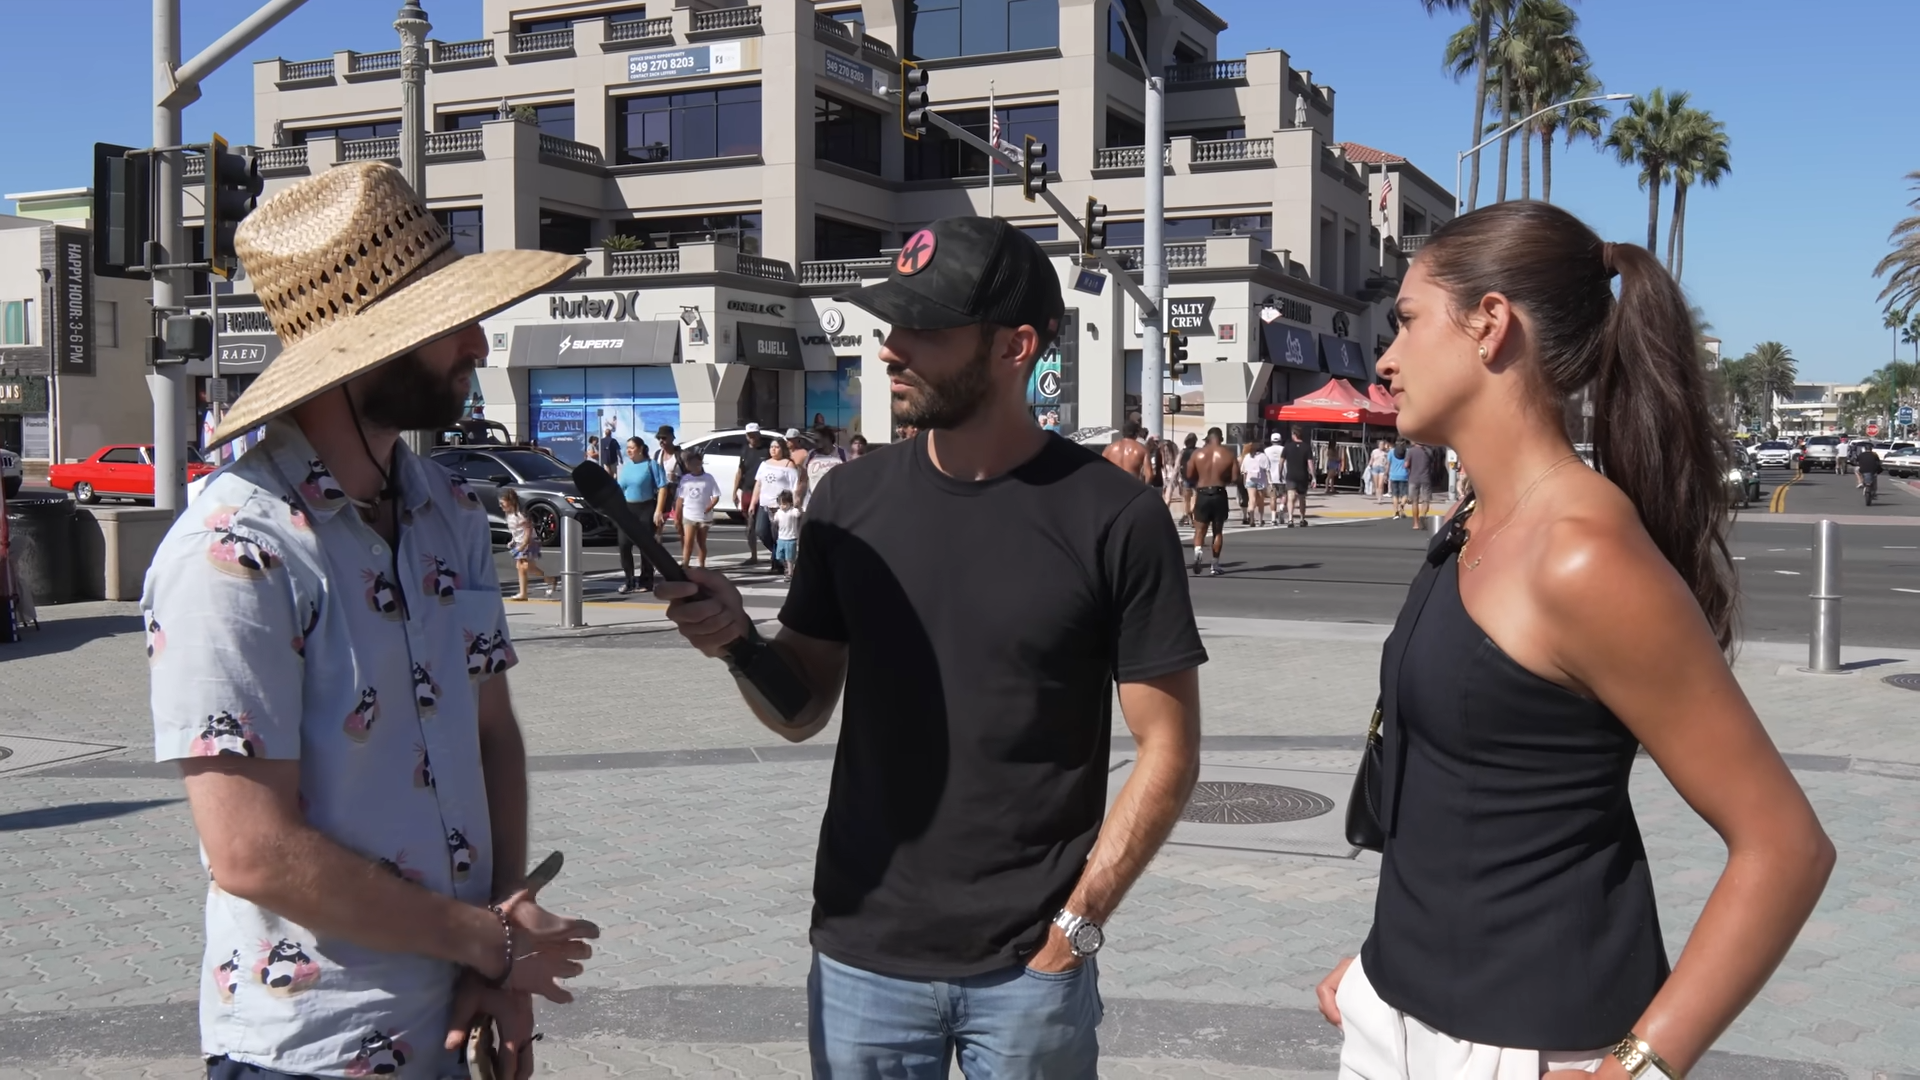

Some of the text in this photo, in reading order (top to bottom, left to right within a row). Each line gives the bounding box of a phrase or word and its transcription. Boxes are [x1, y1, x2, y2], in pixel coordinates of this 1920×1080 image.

[630, 56, 694, 74] 949 270 8203
[826, 59, 838, 72] 949
[838, 64, 850, 77] 270
[850, 68, 864, 83] 8203
[68, 243, 84, 364] HAPPY HOUR: 3-6 PM
[549, 295, 614, 320] Hurley
[1171, 303, 1205, 315] SALTY
[1171, 316, 1203, 328] CREW
[572, 338, 624, 349] SUPER73
[757, 339, 788, 356] BUELL
[222, 349, 258, 359] RAEN
[541, 421, 582, 431] FOR ALL
